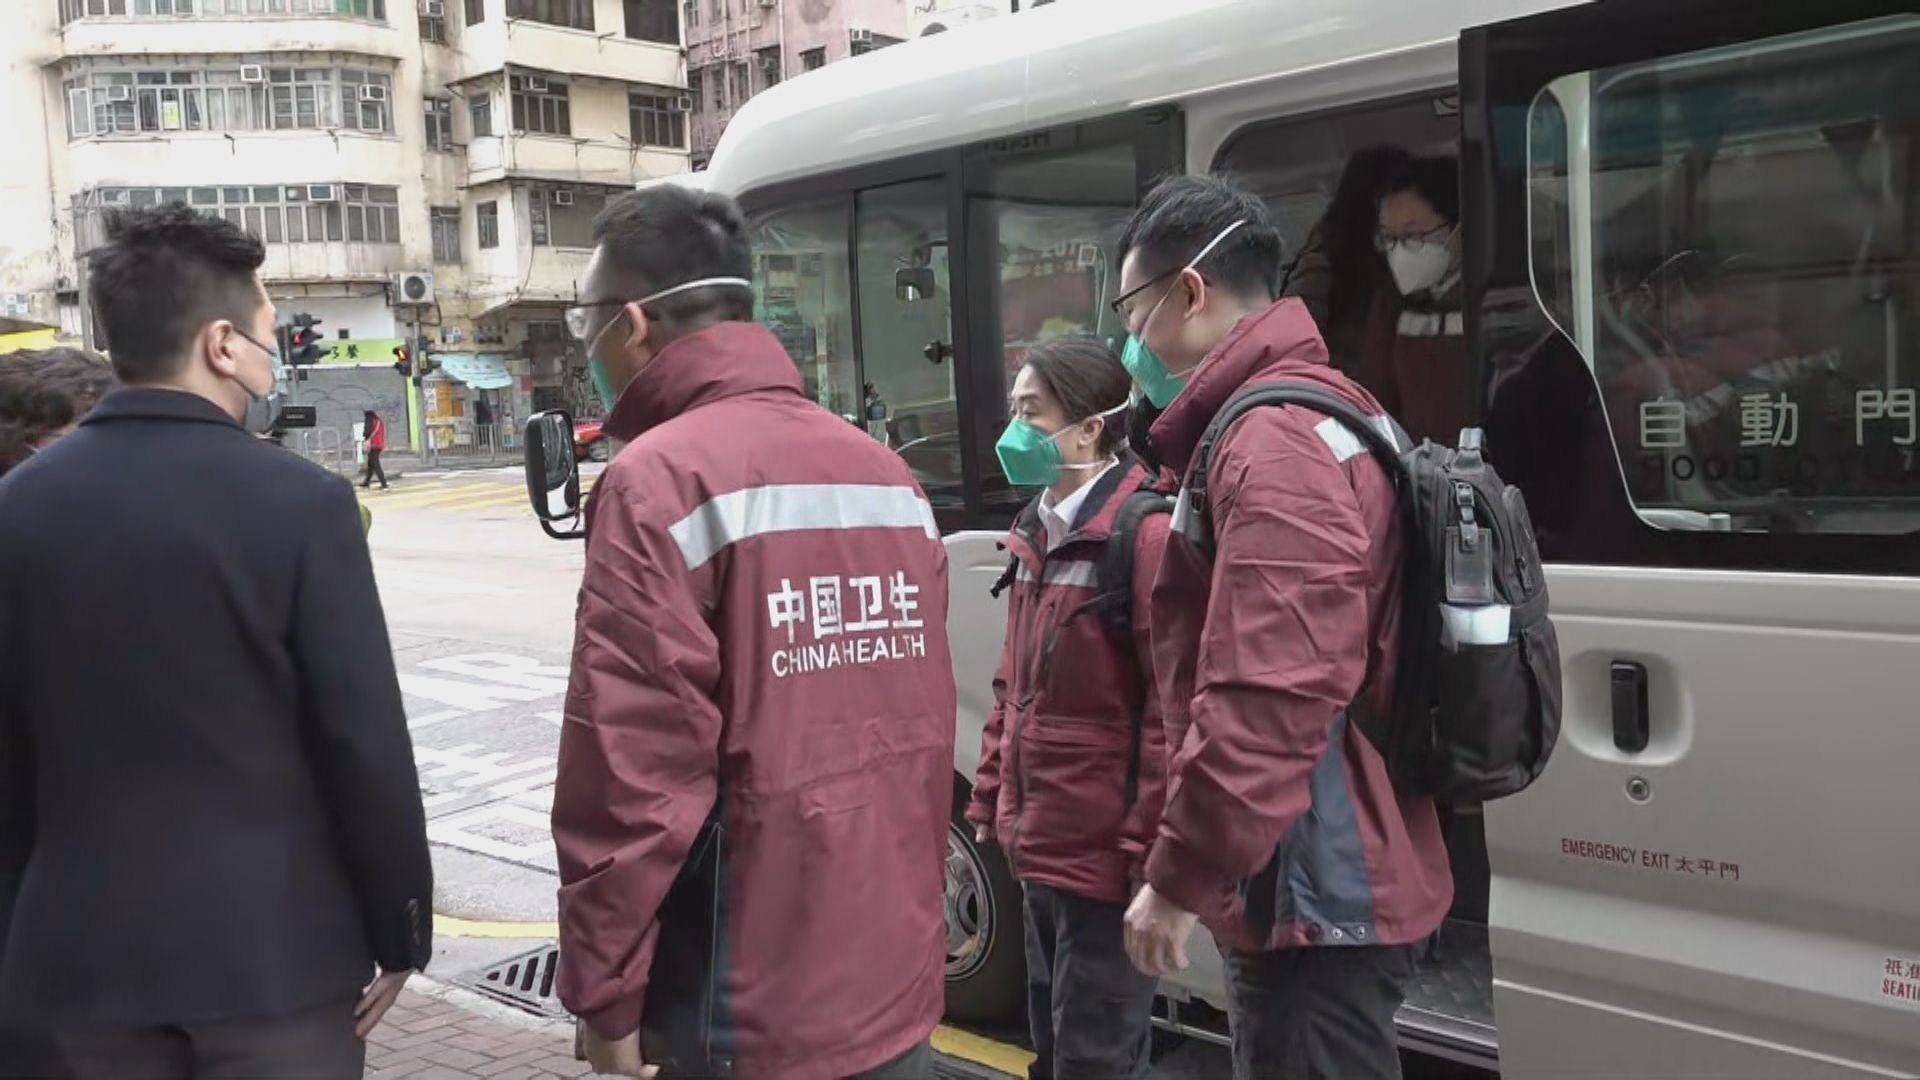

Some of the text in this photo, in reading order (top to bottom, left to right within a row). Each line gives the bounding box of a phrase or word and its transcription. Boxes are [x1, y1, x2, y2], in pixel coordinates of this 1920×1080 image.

[1639, 388, 1917, 448] 自動門
[767, 570, 924, 644] 中国卫生
[1561, 838, 1740, 880] EMERGENCY EXIT 太平門
